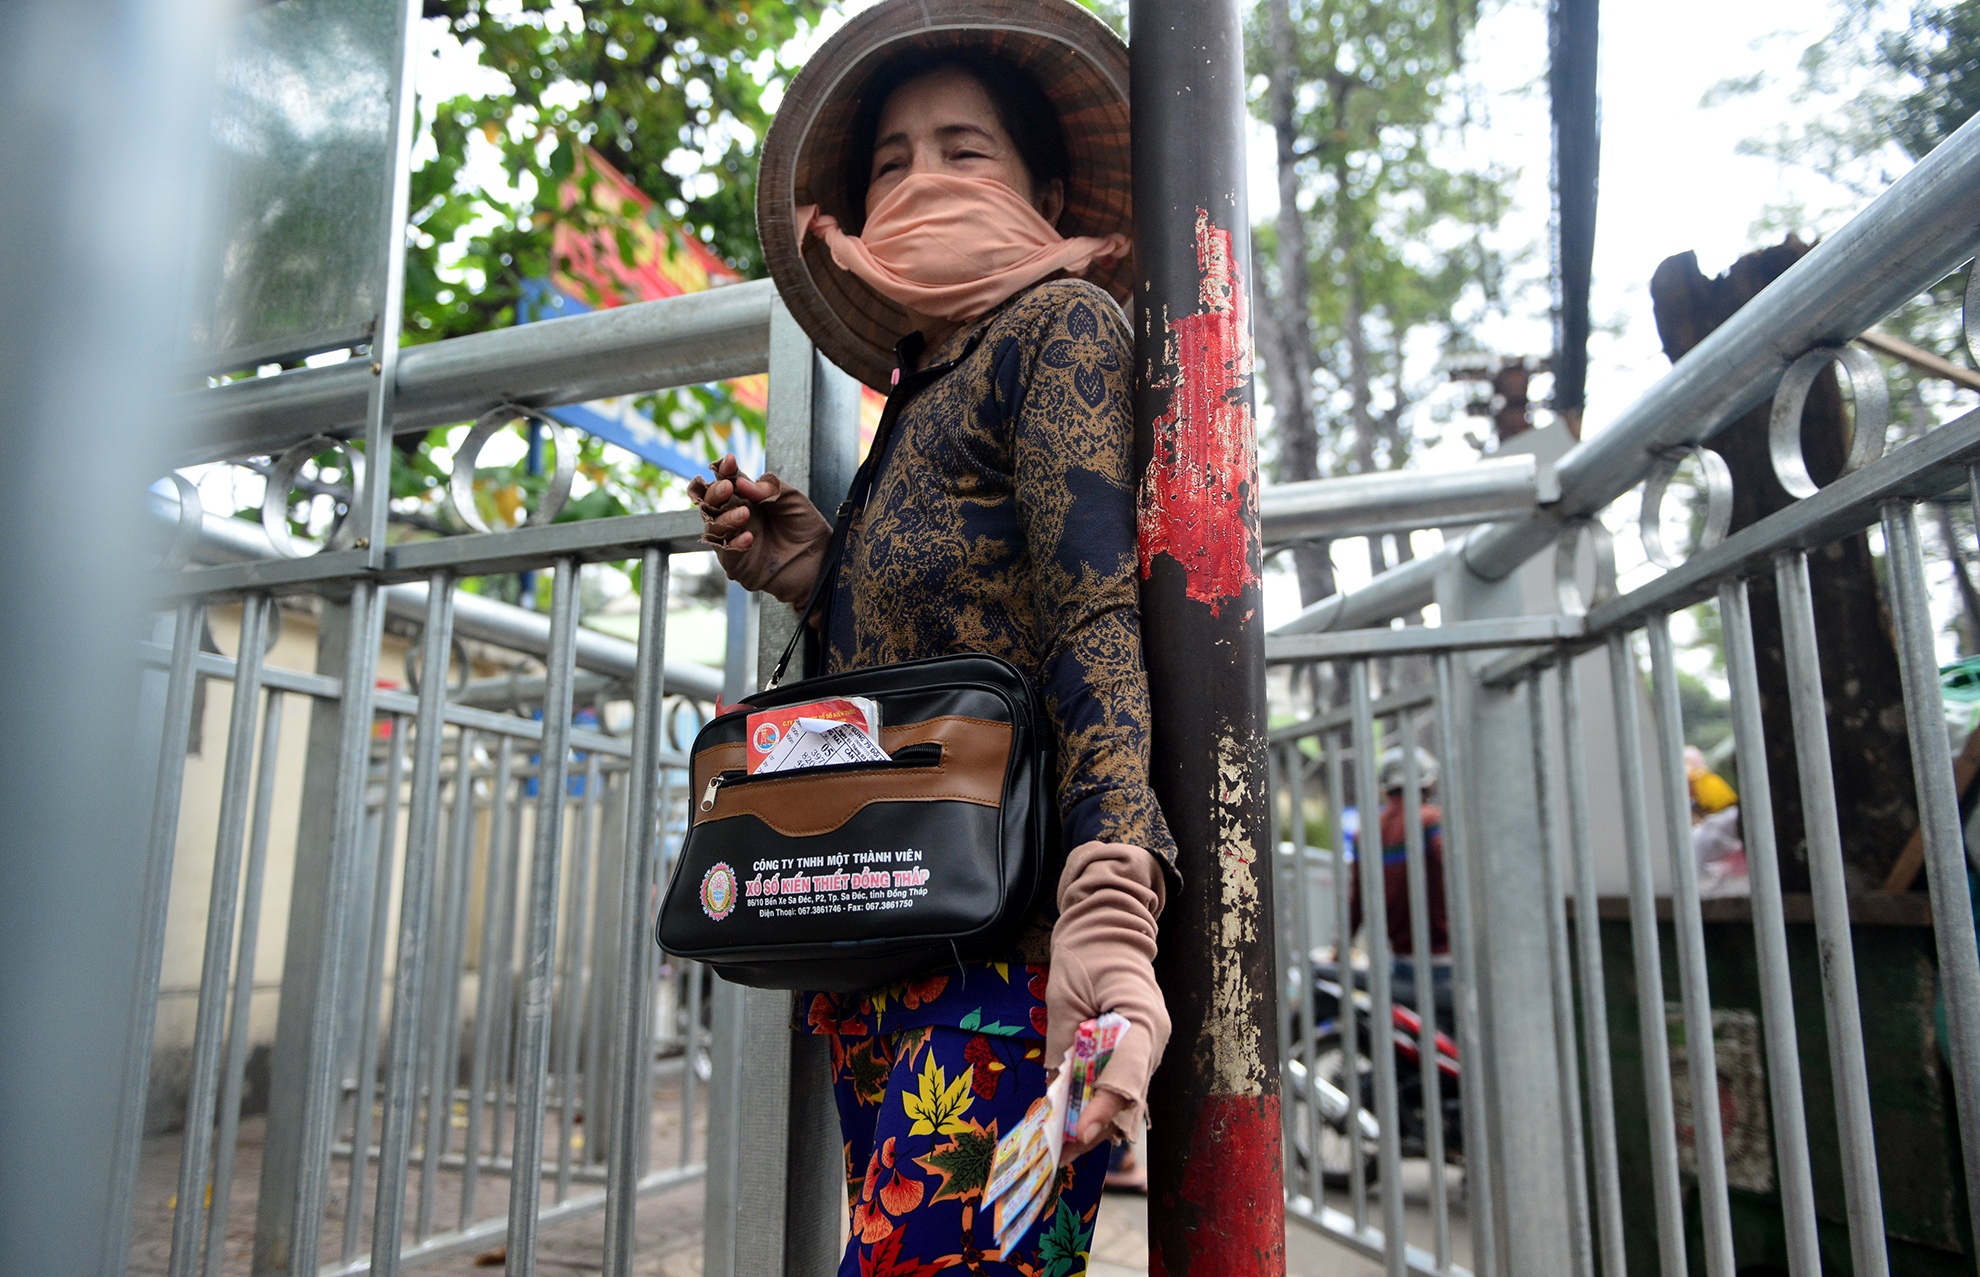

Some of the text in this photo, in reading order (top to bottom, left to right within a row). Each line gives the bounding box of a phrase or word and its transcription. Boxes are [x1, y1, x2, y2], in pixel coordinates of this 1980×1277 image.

[810, 749, 826, 764] 397
[820, 743, 834, 757] 05
[753, 848, 922, 871] CÔNG TY TNHH MỘT THÀNH VIÊN
[745, 865, 930, 897] XỔ SỐ KIẾN THIẾT ĐỒNG THÁP
[747, 898, 764, 907] 86/10
[764, 896, 778, 906] Bến
[778, 897, 787, 905] Xe
[787, 896, 797, 904] Sa
[815, 894, 827, 903] P2,
[828, 893, 839, 904] Tp.
[840, 892, 850, 901] Sa
[870, 889, 885, 899] tỉnh
[908, 887, 928, 897] Tháp
[759, 908, 774, 918] Điện
[775, 907, 797, 917] Thoại:
[797, 904, 842, 915] 067.3861746
[847, 902, 864, 912] Fax:
[865, 899, 913, 910] 067.3861750
